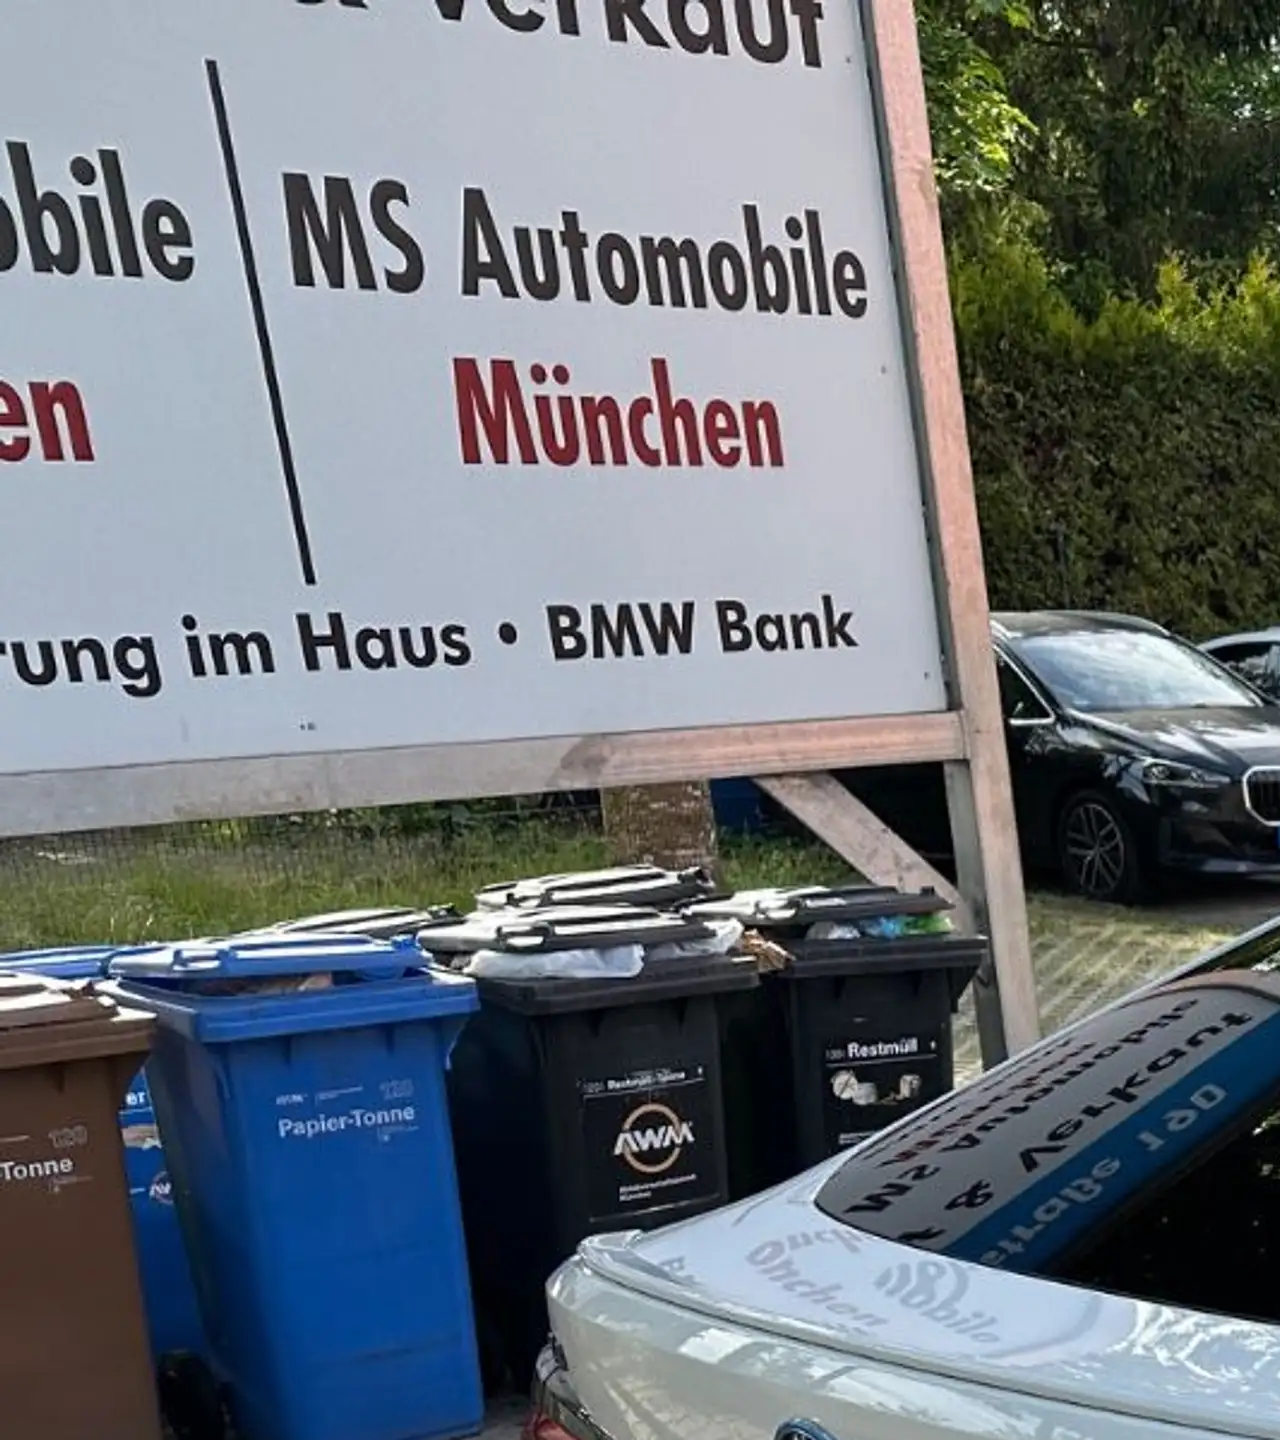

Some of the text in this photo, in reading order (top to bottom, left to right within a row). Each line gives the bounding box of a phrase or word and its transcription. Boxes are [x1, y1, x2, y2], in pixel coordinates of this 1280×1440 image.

[282, 172, 868, 319] MS Automobile
[453, 357, 784, 468] München
[181, 614, 275, 677] im
[295, 612, 472, 672] Haus
[546, 601, 695, 660] BMW
[715, 594, 858, 652] Bank
[846, 1037, 919, 1058] Restmüll
[278, 1105, 416, 1138] Papier-Tonne
[613, 1121, 695, 1156] AWM
